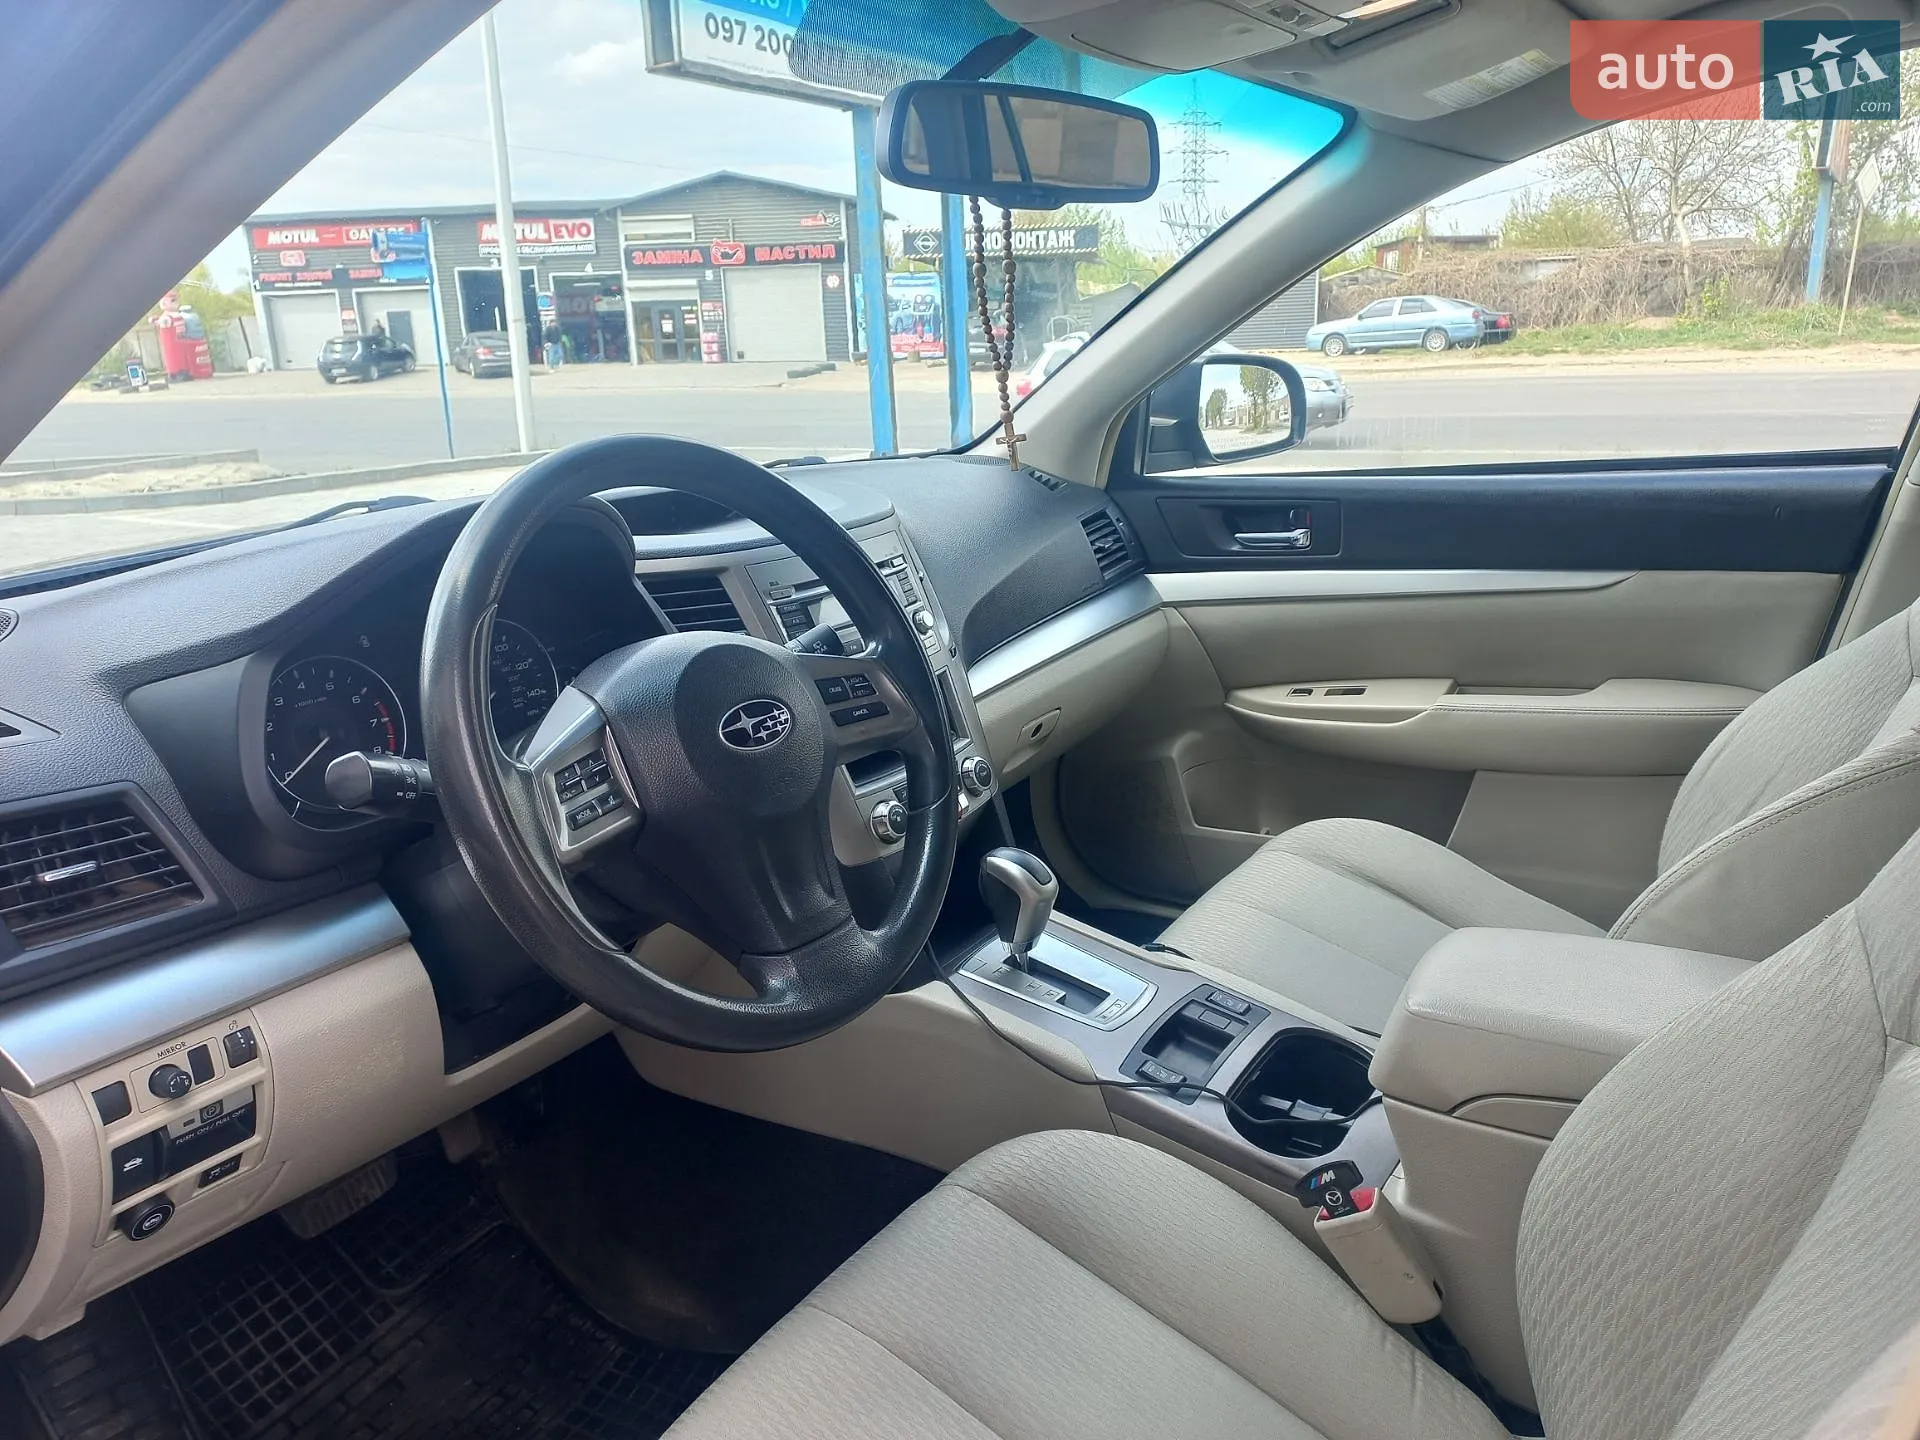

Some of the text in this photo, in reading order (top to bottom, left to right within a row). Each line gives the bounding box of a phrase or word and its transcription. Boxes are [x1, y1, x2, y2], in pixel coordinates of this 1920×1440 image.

[704, 11, 747, 46] 097
[267, 229, 320, 245] MOTUL
[480, 221, 592, 241] MTUL EVO
[704, 269, 714, 281] 5
[297, 681, 306, 689] 4
[527, 688, 541, 698] 140
[273, 696, 284, 706] 3
[351, 695, 361, 704] 6
[266, 722, 274, 732] 2
[369, 717, 378, 729] 7
[157, 1041, 187, 1059] MIRROR
